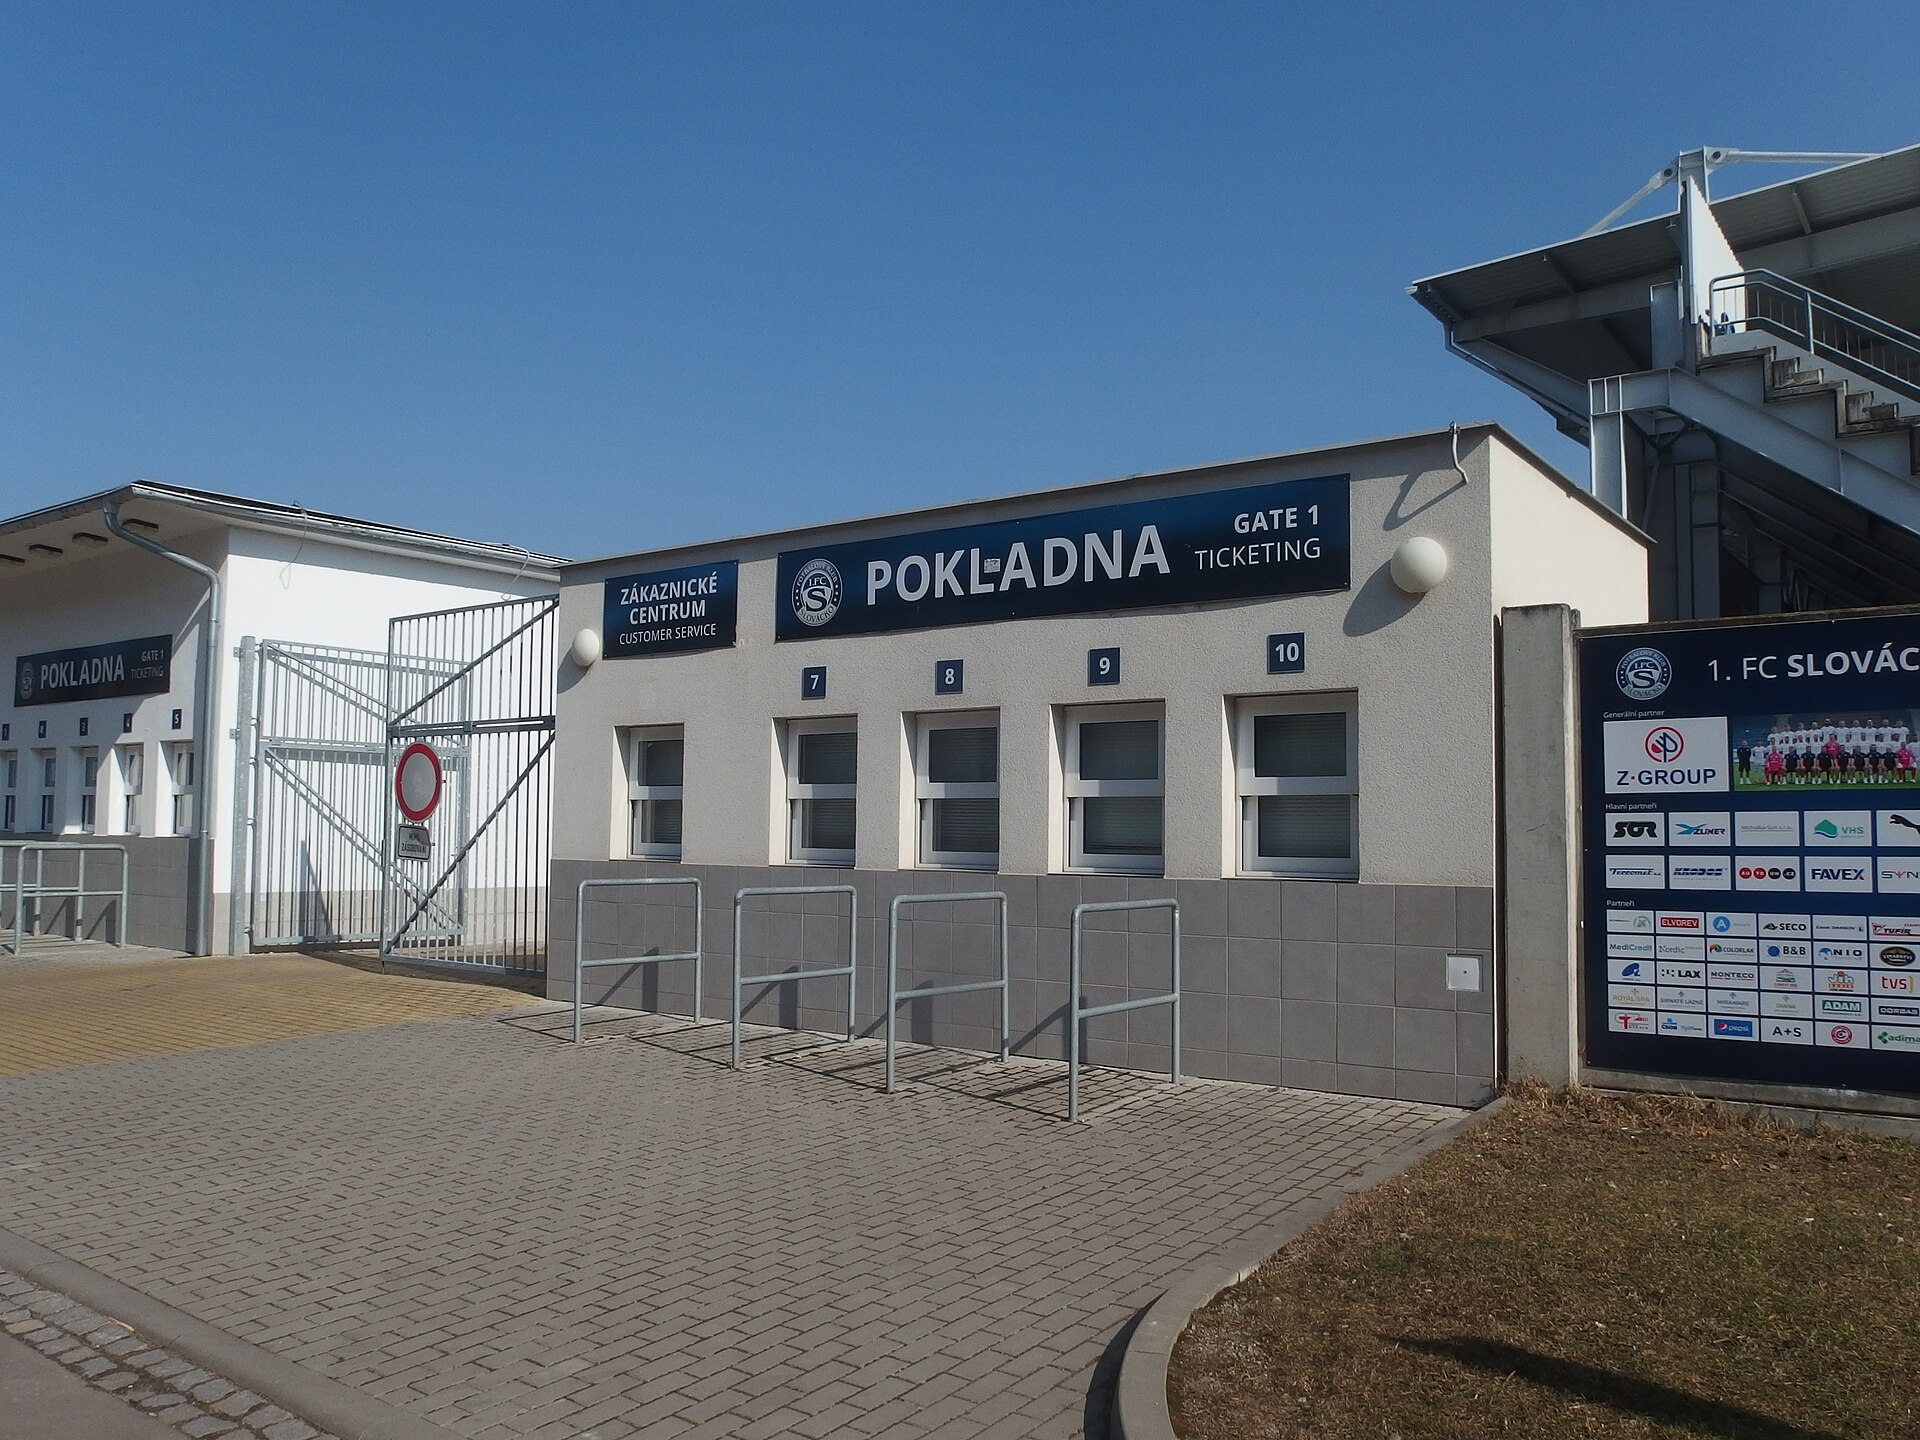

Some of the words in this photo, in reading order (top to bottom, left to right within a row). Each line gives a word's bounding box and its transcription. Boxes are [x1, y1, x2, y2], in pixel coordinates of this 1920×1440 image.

[1234, 506, 1298, 534] GATE
[1307, 504, 1318, 525] 1
[1194, 537, 1321, 570] TICKETING
[867, 524, 1171, 606] POKLADNA
[620, 571, 718, 606] ZÁKAZNICKÉ
[629, 599, 706, 625] CENTRUM
[619, 628, 673, 645] CUSTOMER
[675, 623, 717, 639] SERVICE
[141, 650, 159, 662] GATE
[1275, 642, 1299, 662] 10
[40, 654, 125, 690] POKLADNA
[131, 665, 164, 680] TICKETING
[1099, 657, 1110, 675] 9
[1708, 659, 1731, 682] 1.
[1742, 656, 1777, 680] FC
[810, 674, 820, 690] 7
[945, 668, 955, 685] 8
[174, 713, 180, 725] 5
[1603, 710, 1637, 719] Generální
[1638, 709, 1665, 719] partner
[1605, 802, 1628, 810] Hlavní
[1841, 826, 1864, 834] VHS
[1811, 868, 1865, 881] FAVEX
[1661, 918, 1698, 927] ELVOREV
[1779, 923, 1807, 931] SECO
[1609, 943, 1652, 952] MediCredit
[1658, 945, 1685, 953] Nordic
[1783, 946, 1806, 955] B&B
[1710, 971, 1755, 979] MONTECO
[1823, 1001, 1860, 1011] ADAM
